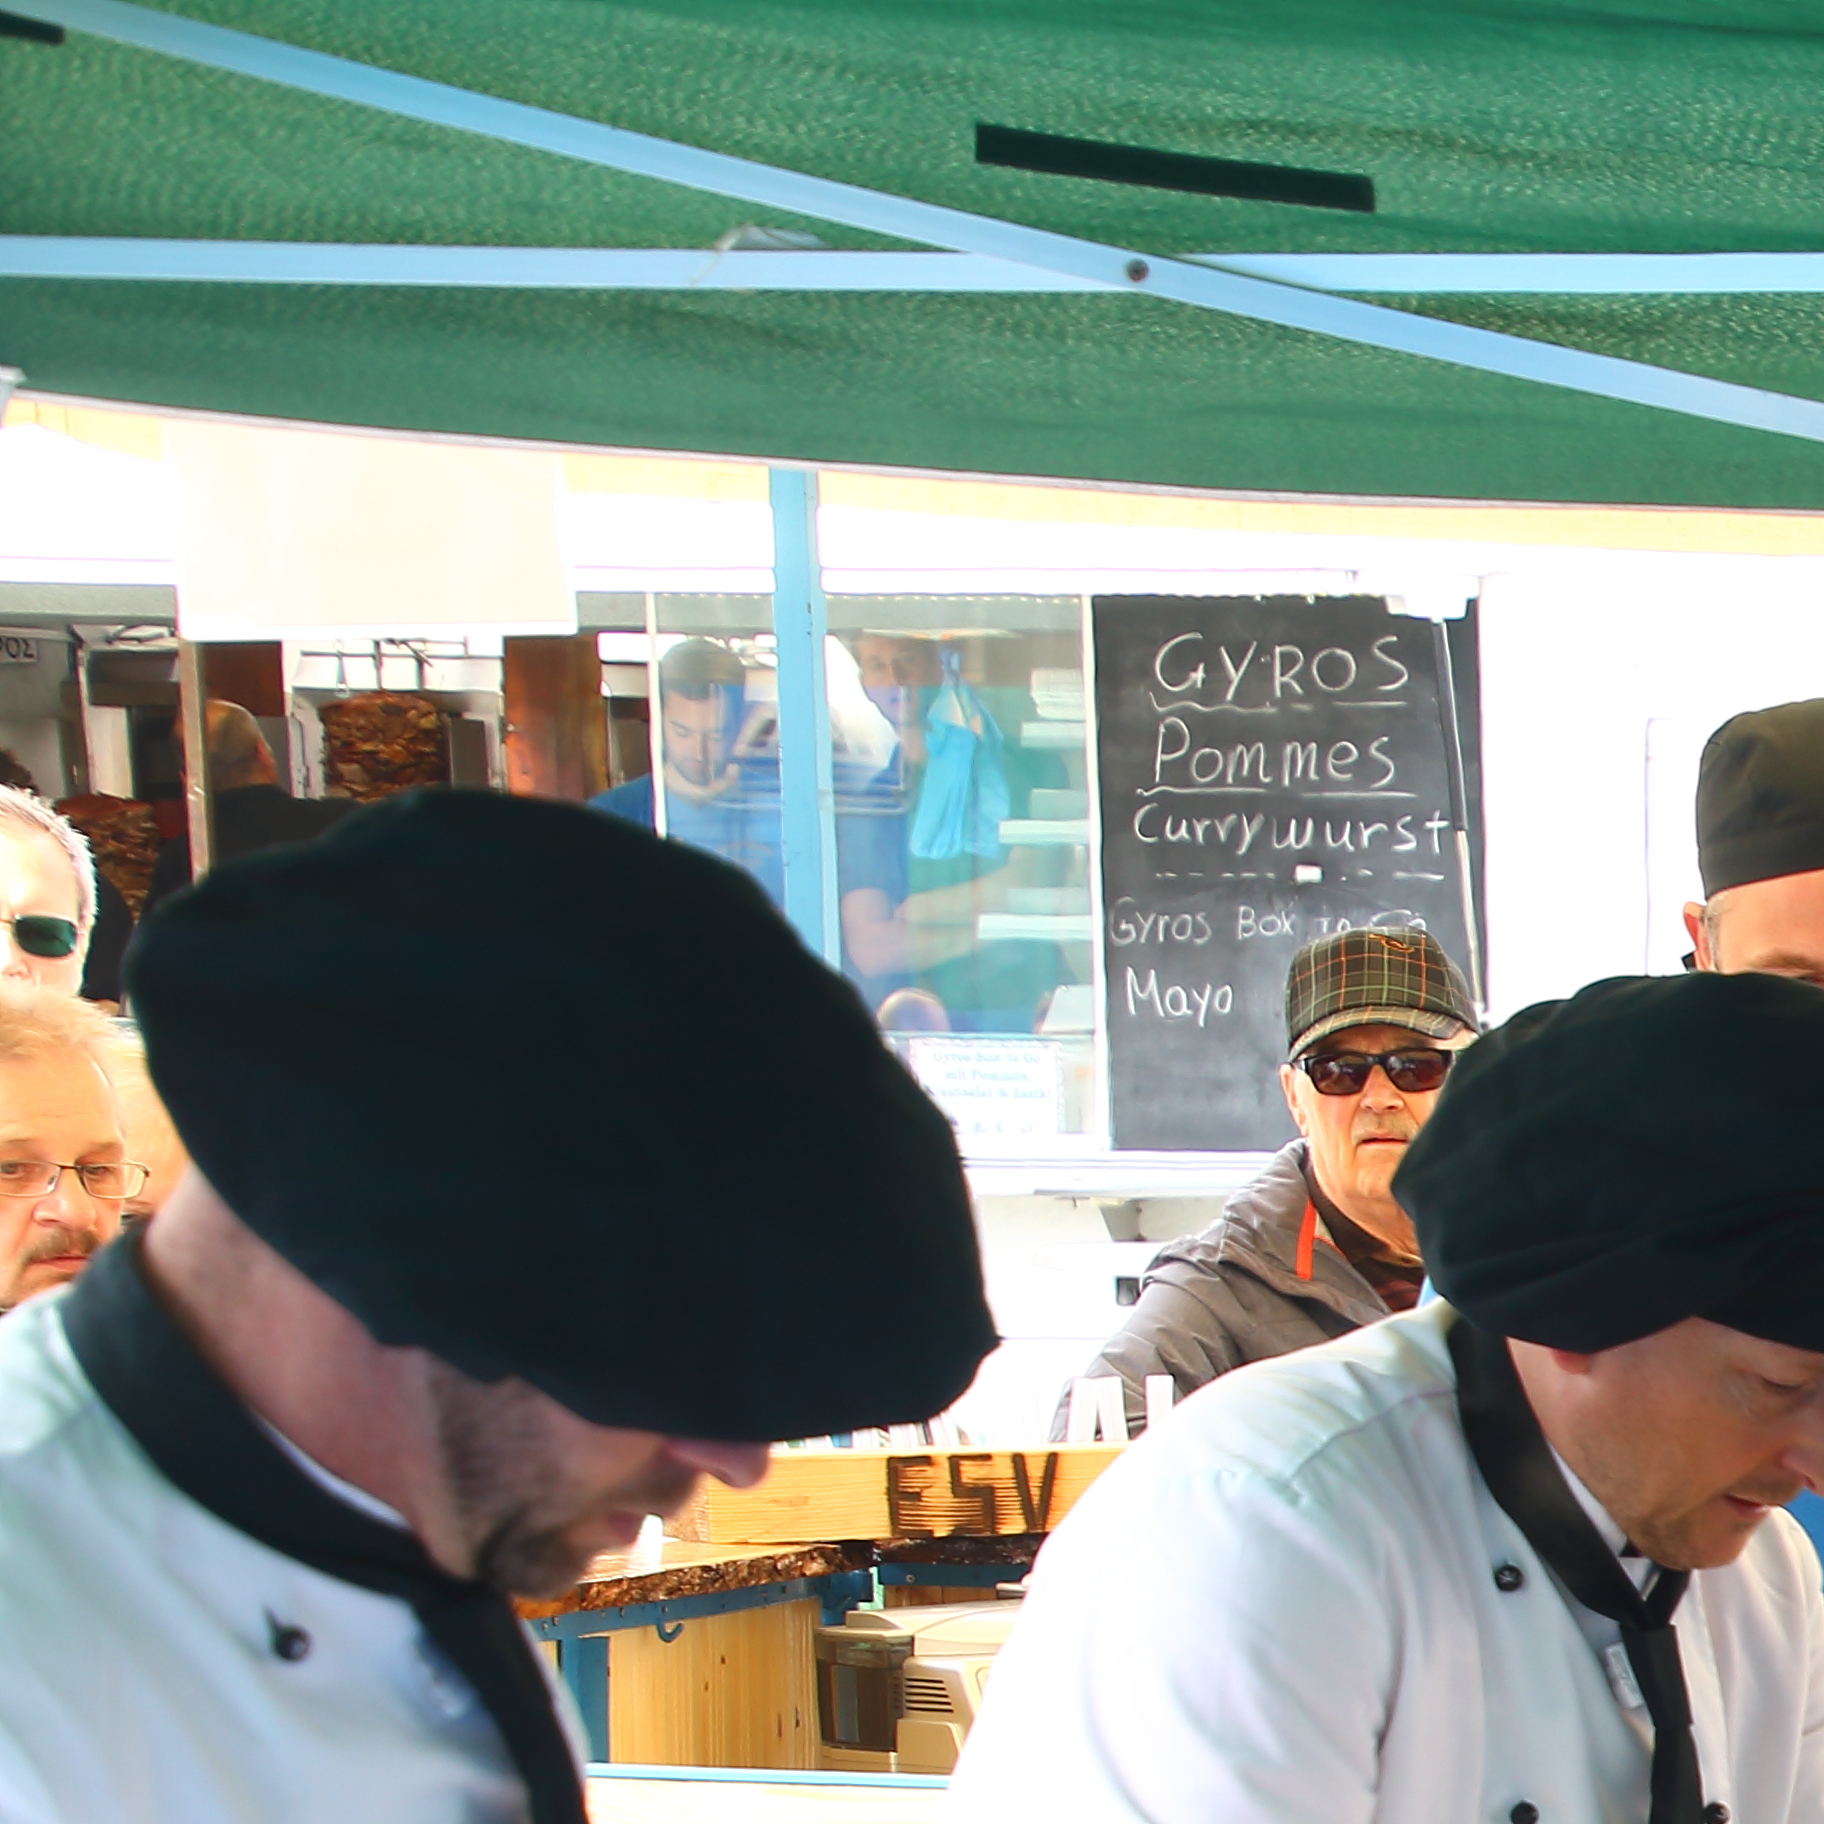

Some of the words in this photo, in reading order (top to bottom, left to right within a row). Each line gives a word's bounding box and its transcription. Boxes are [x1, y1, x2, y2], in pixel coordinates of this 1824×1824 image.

[1154, 631, 1409, 700] GYROS
[1154, 716, 1395, 788] Pommes
[1110, 896, 1212, 947] Gyros
[1236, 904, 1297, 941] Box
[1125, 965, 1233, 1028] Mayo
[887, 1452, 1059, 1538] ESV
